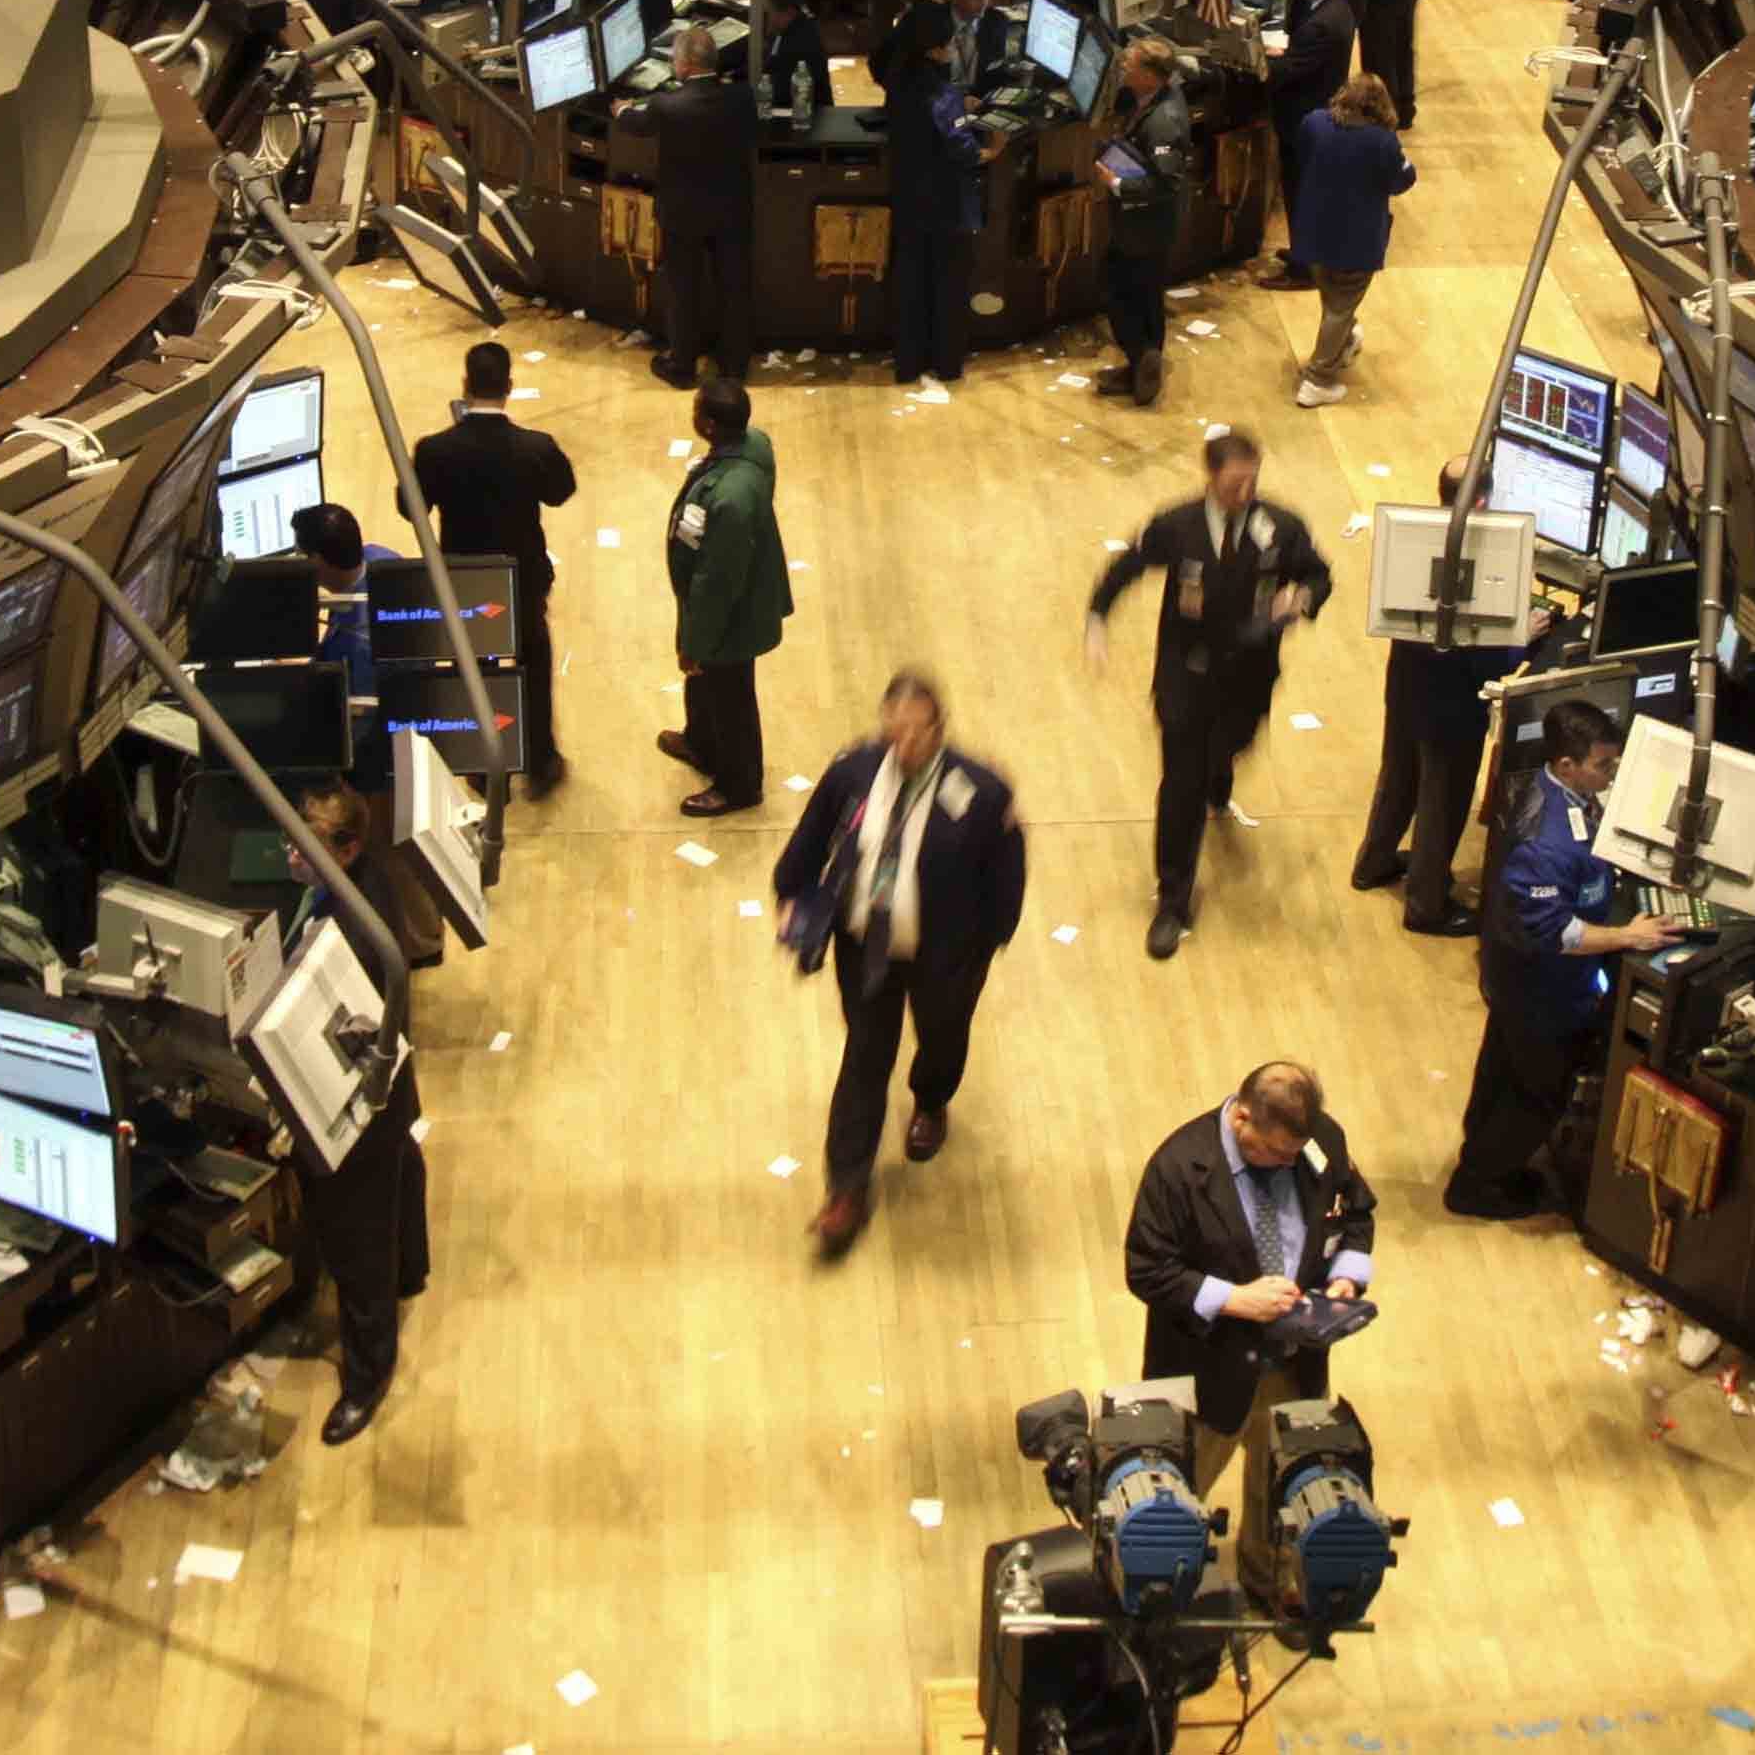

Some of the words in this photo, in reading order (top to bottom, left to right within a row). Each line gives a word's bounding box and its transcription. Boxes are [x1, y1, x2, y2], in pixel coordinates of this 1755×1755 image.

[377, 610, 408, 621] Bank
[410, 608, 422, 620] of
[423, 608, 474, 620] Amca
[419, 719, 431, 731] of
[432, 718, 479, 731] Americ
